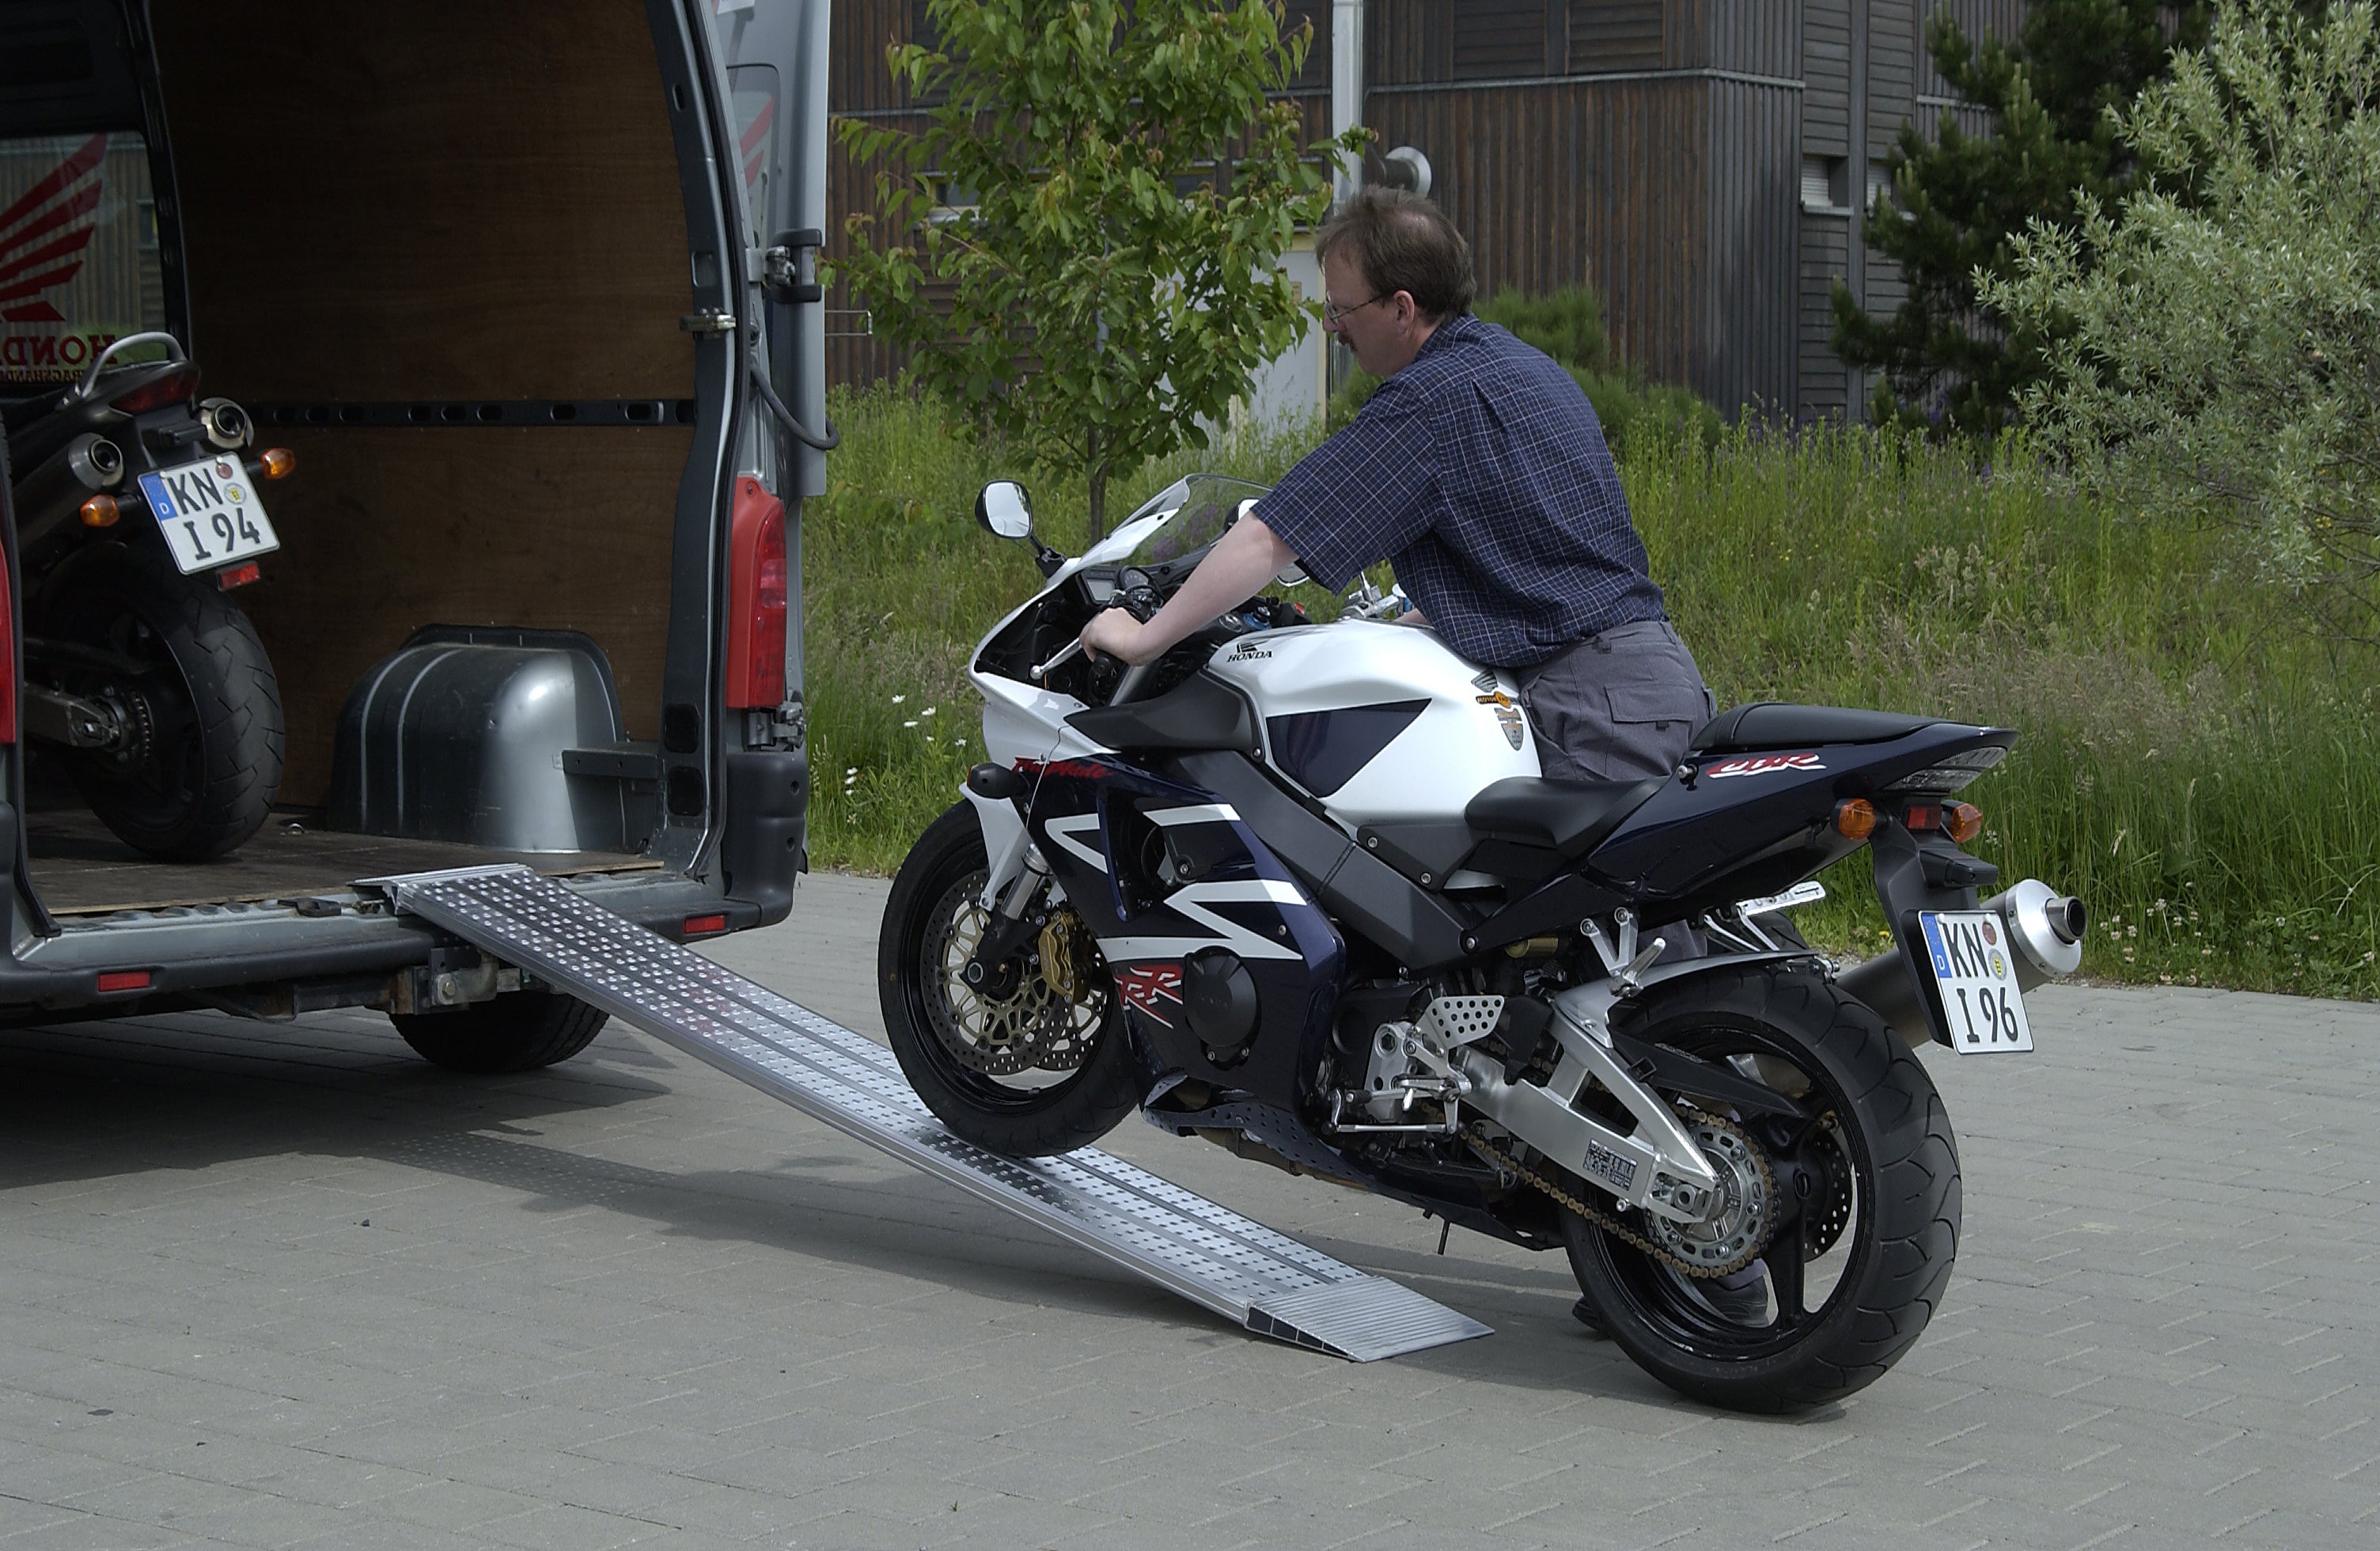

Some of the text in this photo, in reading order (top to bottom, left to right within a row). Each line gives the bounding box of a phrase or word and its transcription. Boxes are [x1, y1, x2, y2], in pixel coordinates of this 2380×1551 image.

[158, 502, 170, 514] D
[166, 468, 223, 515] KN
[183, 507, 260, 560] I 94
[1226, 650, 1272, 663] HONDA
[1936, 955, 1946, 970] D
[1941, 923, 1990, 977] KN
[1956, 987, 2018, 1043] I 96
